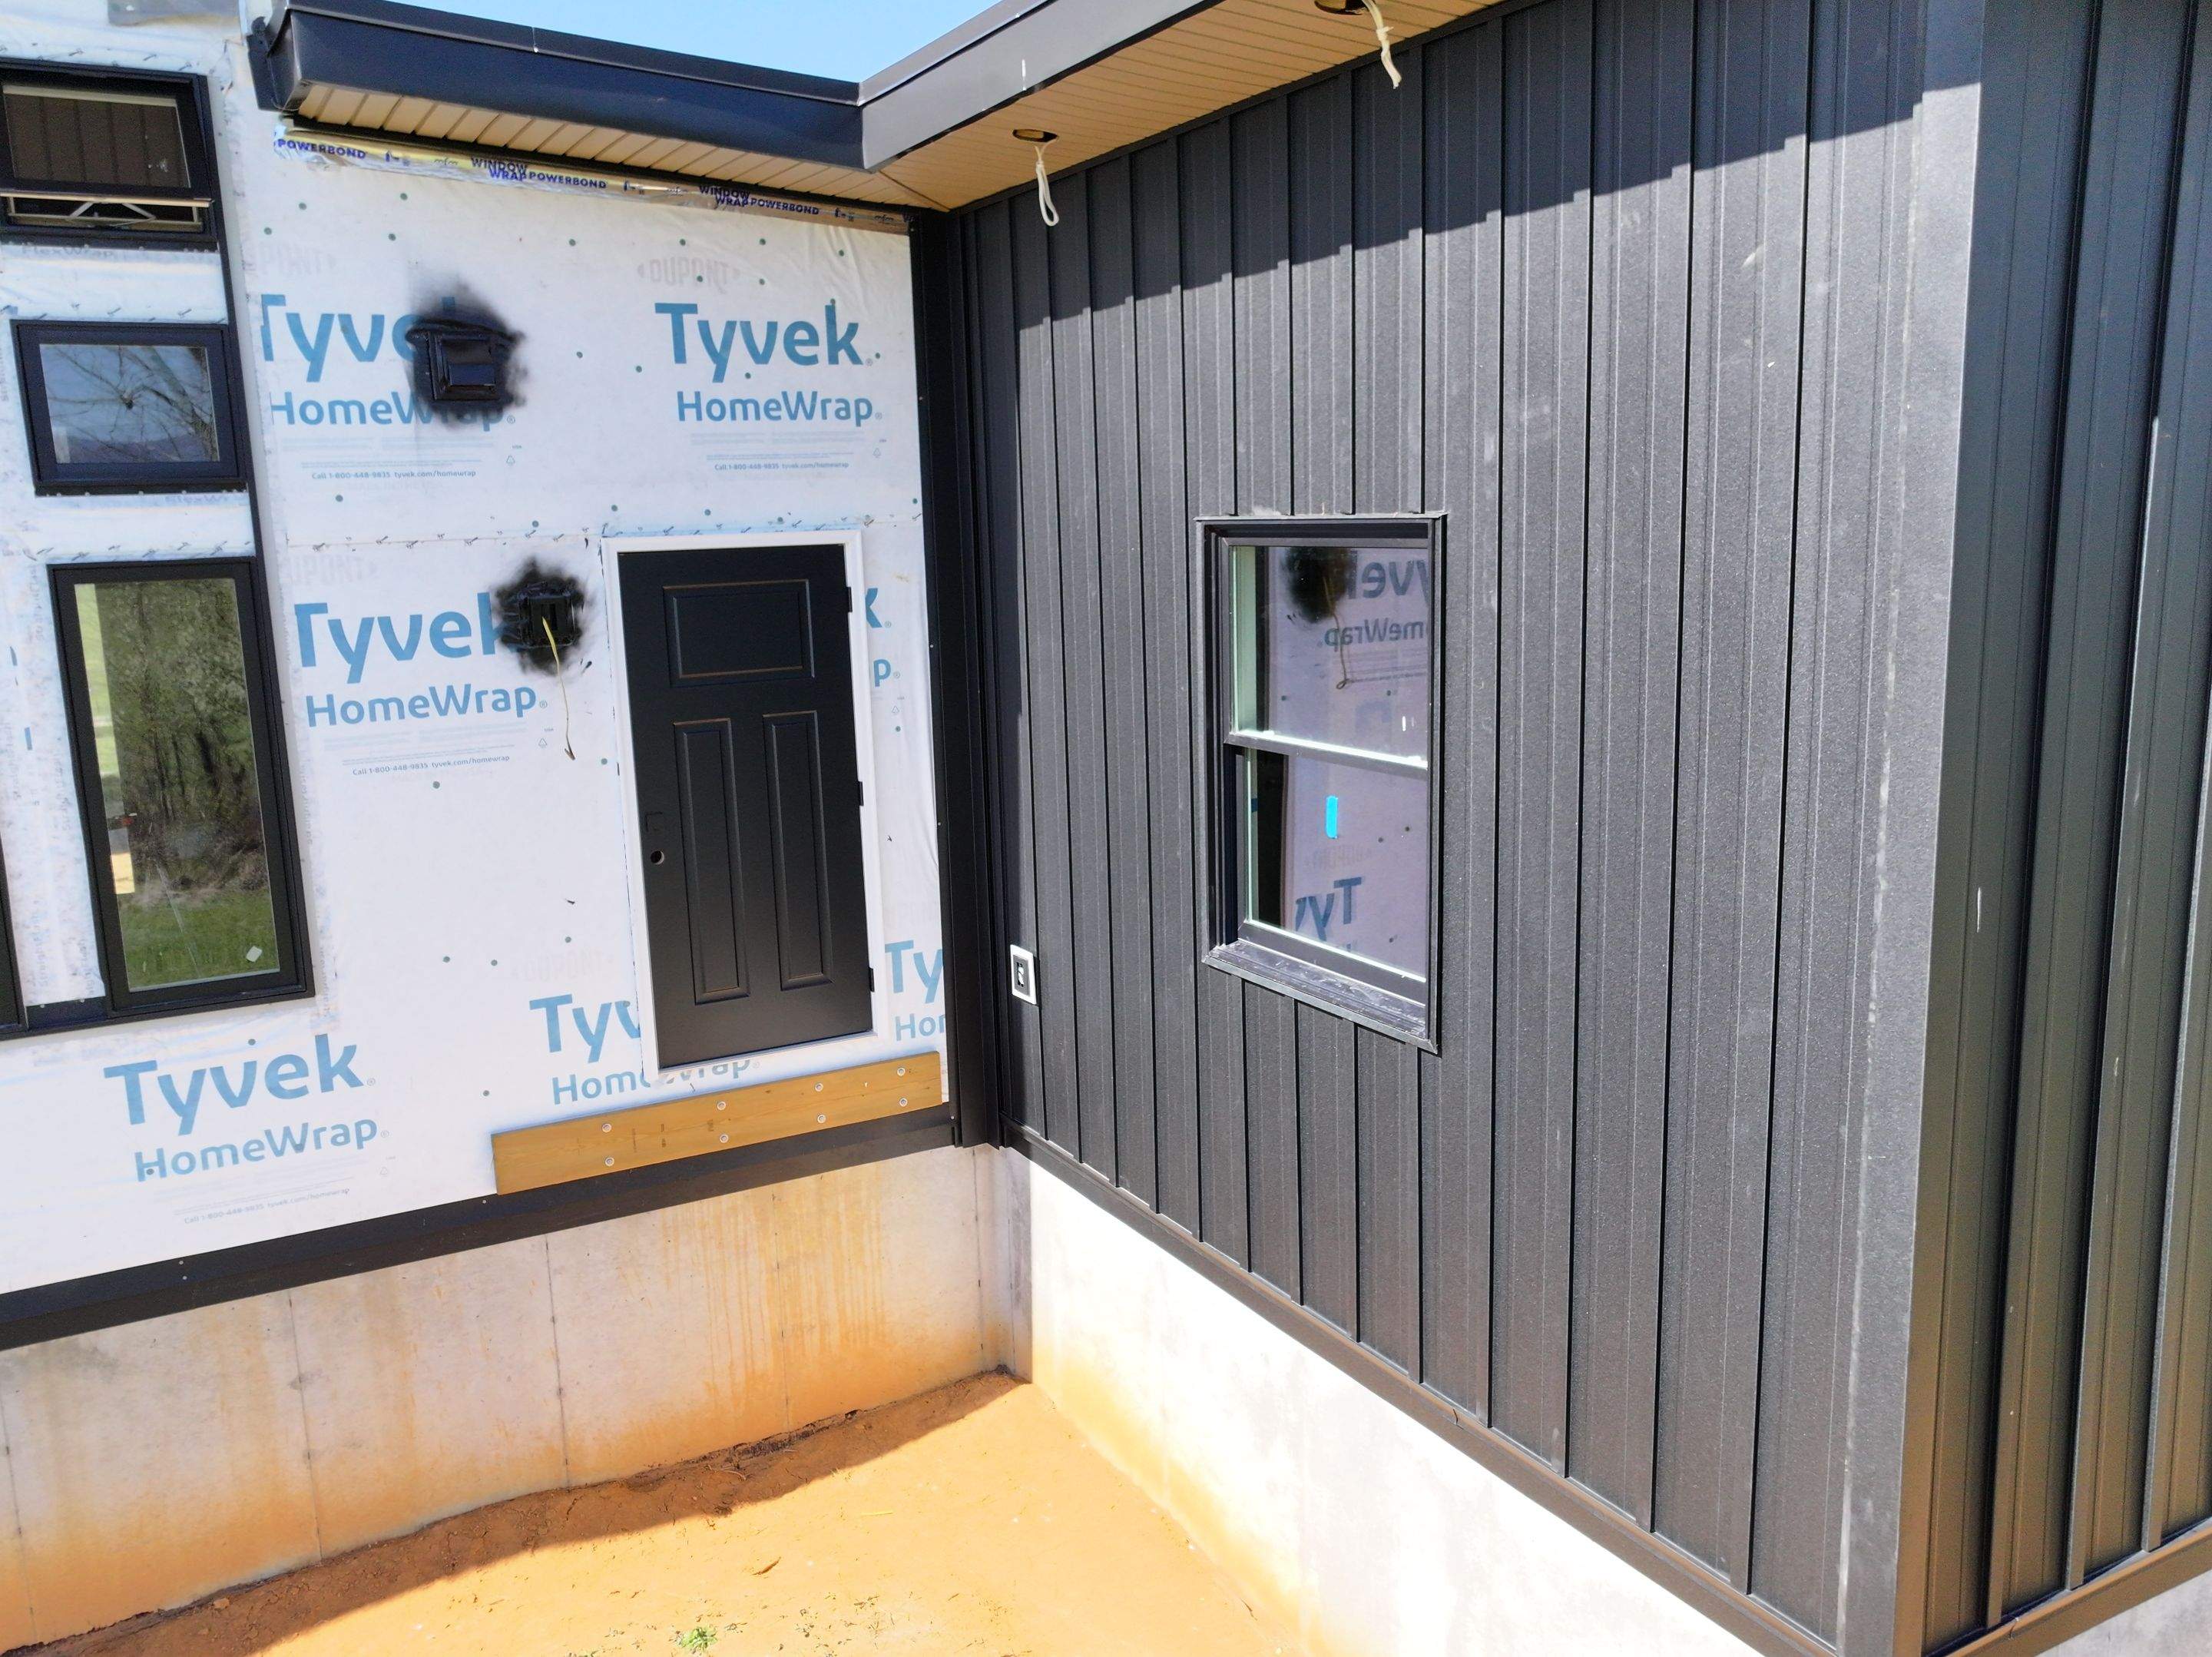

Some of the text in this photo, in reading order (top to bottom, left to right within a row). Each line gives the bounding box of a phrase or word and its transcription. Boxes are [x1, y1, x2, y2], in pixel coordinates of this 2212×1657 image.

[277, 138, 366, 159] POWERBOND
[471, 157, 528, 172] WINDOW
[489, 169, 607, 189] WRAP POWERBOND
[700, 185, 750, 199] WINDOW
[716, 196, 819, 215] WRAP POWERBOND
[654, 303, 864, 383] Tyvek
[677, 390, 873, 427] HomeWrap
[306, 683, 536, 727] HomeWrap
[353, 755, 510, 776] Call 1-800-448-9835 tyvek.com/homewrap
[103, 1033, 364, 1136] Tyvek
[134, 1118, 378, 1182] HomeWrap
